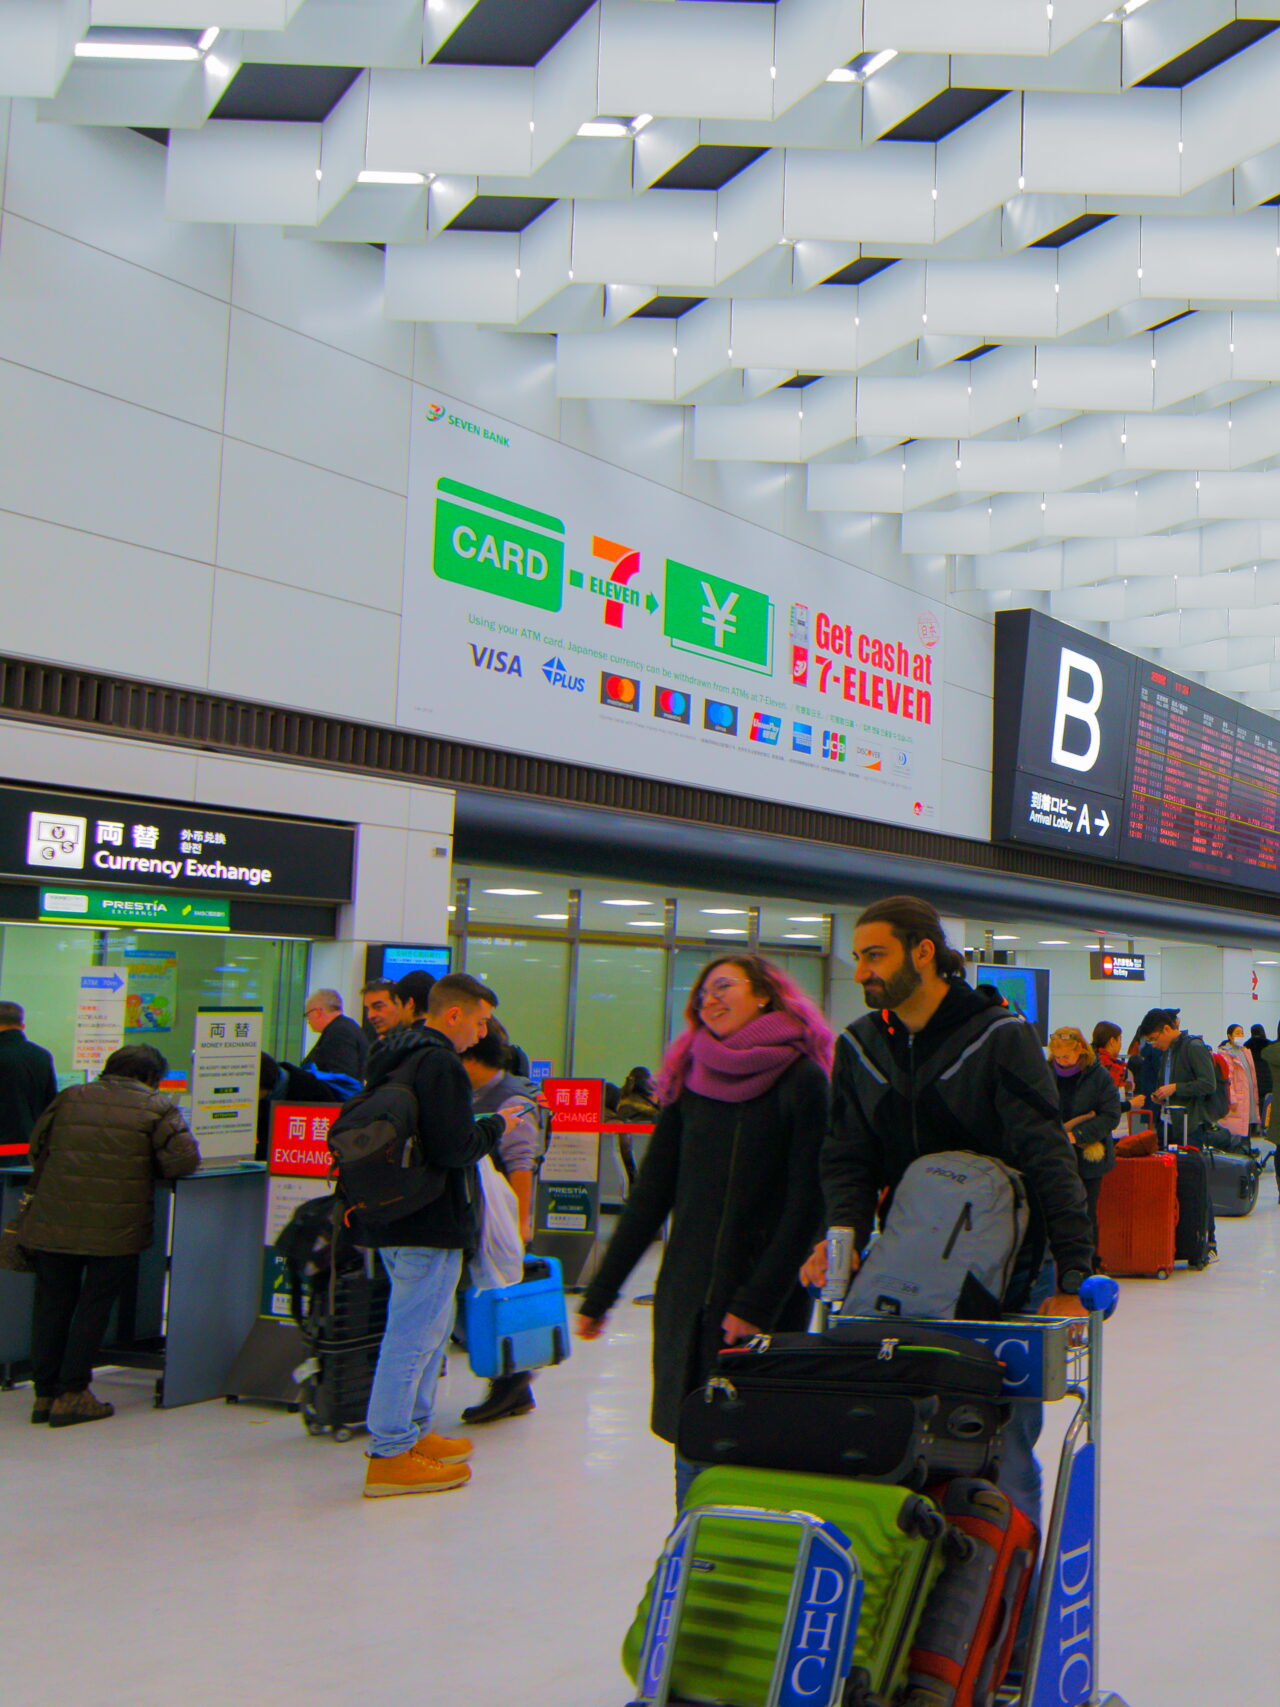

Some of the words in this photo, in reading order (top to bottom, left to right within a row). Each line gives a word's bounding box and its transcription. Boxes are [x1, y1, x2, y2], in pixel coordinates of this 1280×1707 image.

[448, 414, 480, 436] SEVEN
[482, 429, 511, 447] BANK
[452, 525, 549, 581] CARD
[466, 641, 523, 678] VISA
[468, 613, 496, 631] Using
[498, 624, 518, 636] your
[520, 628, 541, 641] ATM
[567, 641, 608, 660] Japanese
[610, 654, 645, 672] currency
[646, 664, 660, 674] can
[662, 668, 673, 679] be
[673, 672, 712, 688] withdrawn
[713, 681, 730, 695] from
[730, 685, 749, 699] ATMs
[815, 611, 852, 659] Get
[858, 633, 909, 678] cash
[912, 653, 932, 686] at
[552, 671, 586, 693] PLUS
[1051, 646, 1103, 772] B
[822, 739, 846, 754] JCB
[95, 819, 160, 850] 両替
[1029, 810, 1051, 826] Arrival
[1053, 814, 1073, 832] Lobby
[1076, 803, 1091, 835] A
[93, 850, 183, 879] Currency
[185, 858, 272, 886] Exchange
[111, 909, 158, 917] EXCHANGE
[210, 1022, 250, 1039] 両替
[555, 1088, 589, 1106] 両替
[288, 1115, 331, 1141] 両替
[552, 1112, 598, 1123] XCHANGE
[273, 1149, 334, 1165] EXCHANG
[791, 1566, 844, 1696] DHC
[1058, 1538, 1092, 1704] DHC
